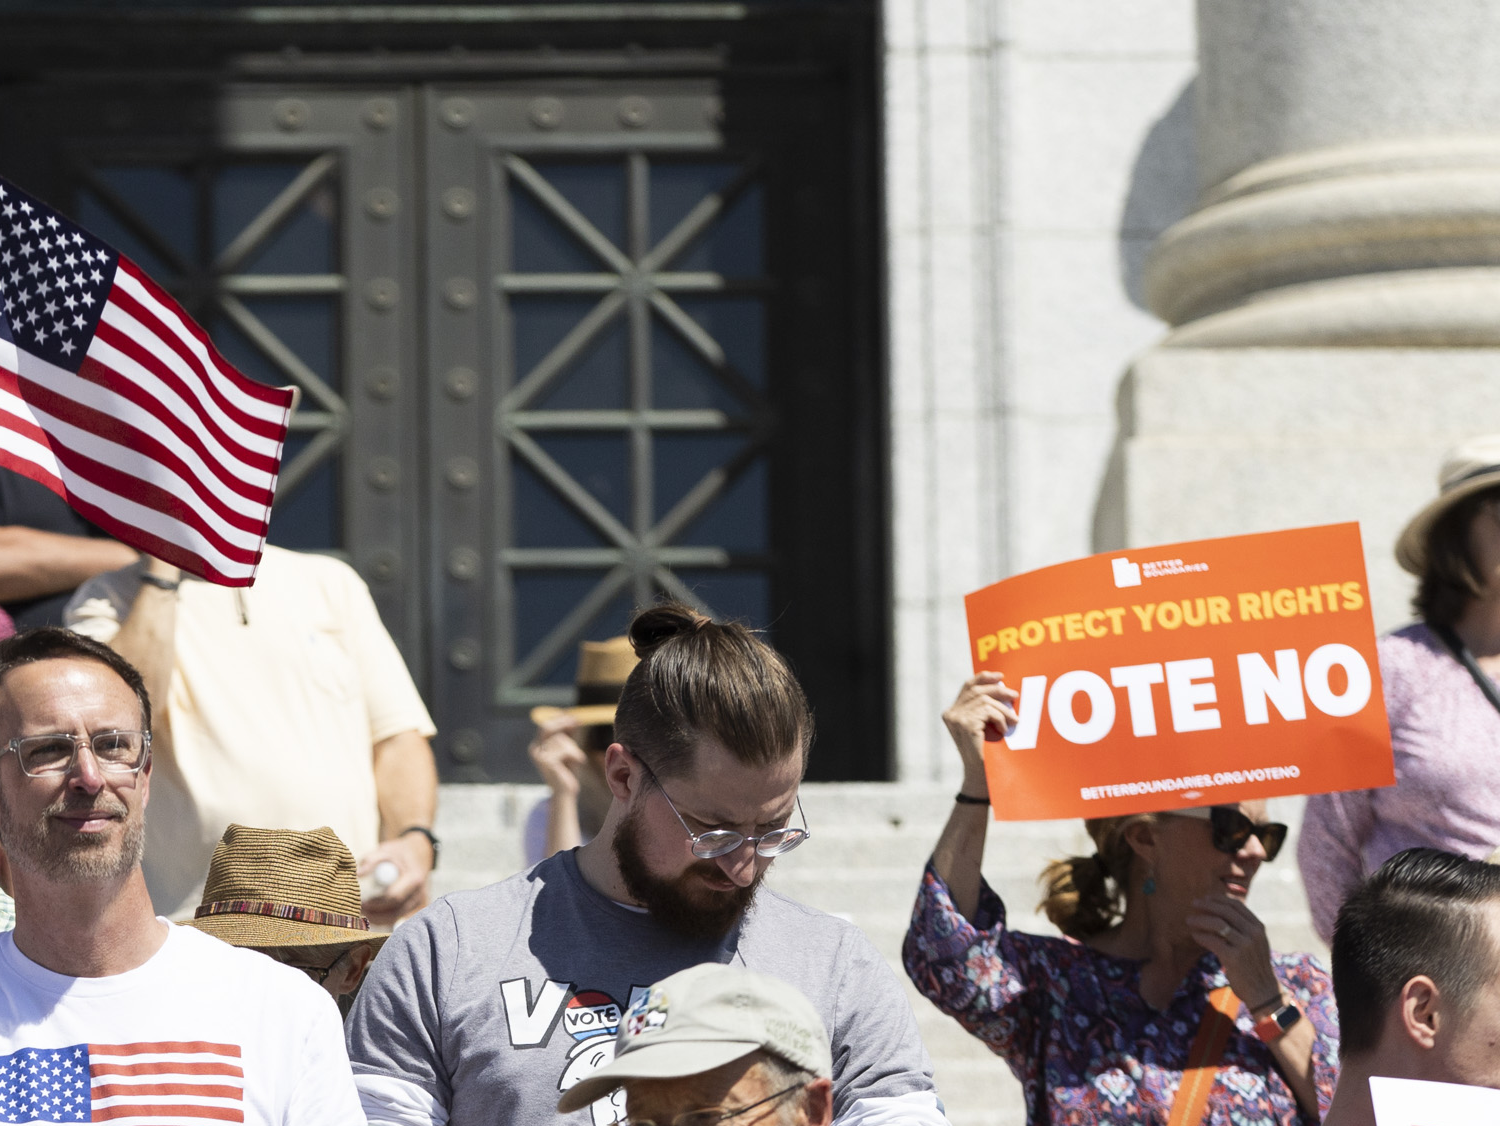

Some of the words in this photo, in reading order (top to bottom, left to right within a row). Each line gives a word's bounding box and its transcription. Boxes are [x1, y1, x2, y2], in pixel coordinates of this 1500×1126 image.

[976, 607, 1127, 662] PROTECT
[1131, 596, 1232, 632] YOUR
[1238, 581, 1364, 621] RIGHTS
[1003, 657, 1222, 750] VOTE
[1236, 642, 1372, 726] NO
[1080, 765, 1300, 800] BETTERBOUNDARIES.ORG/VOTENO
[566, 1006, 618, 1027] VOTE
